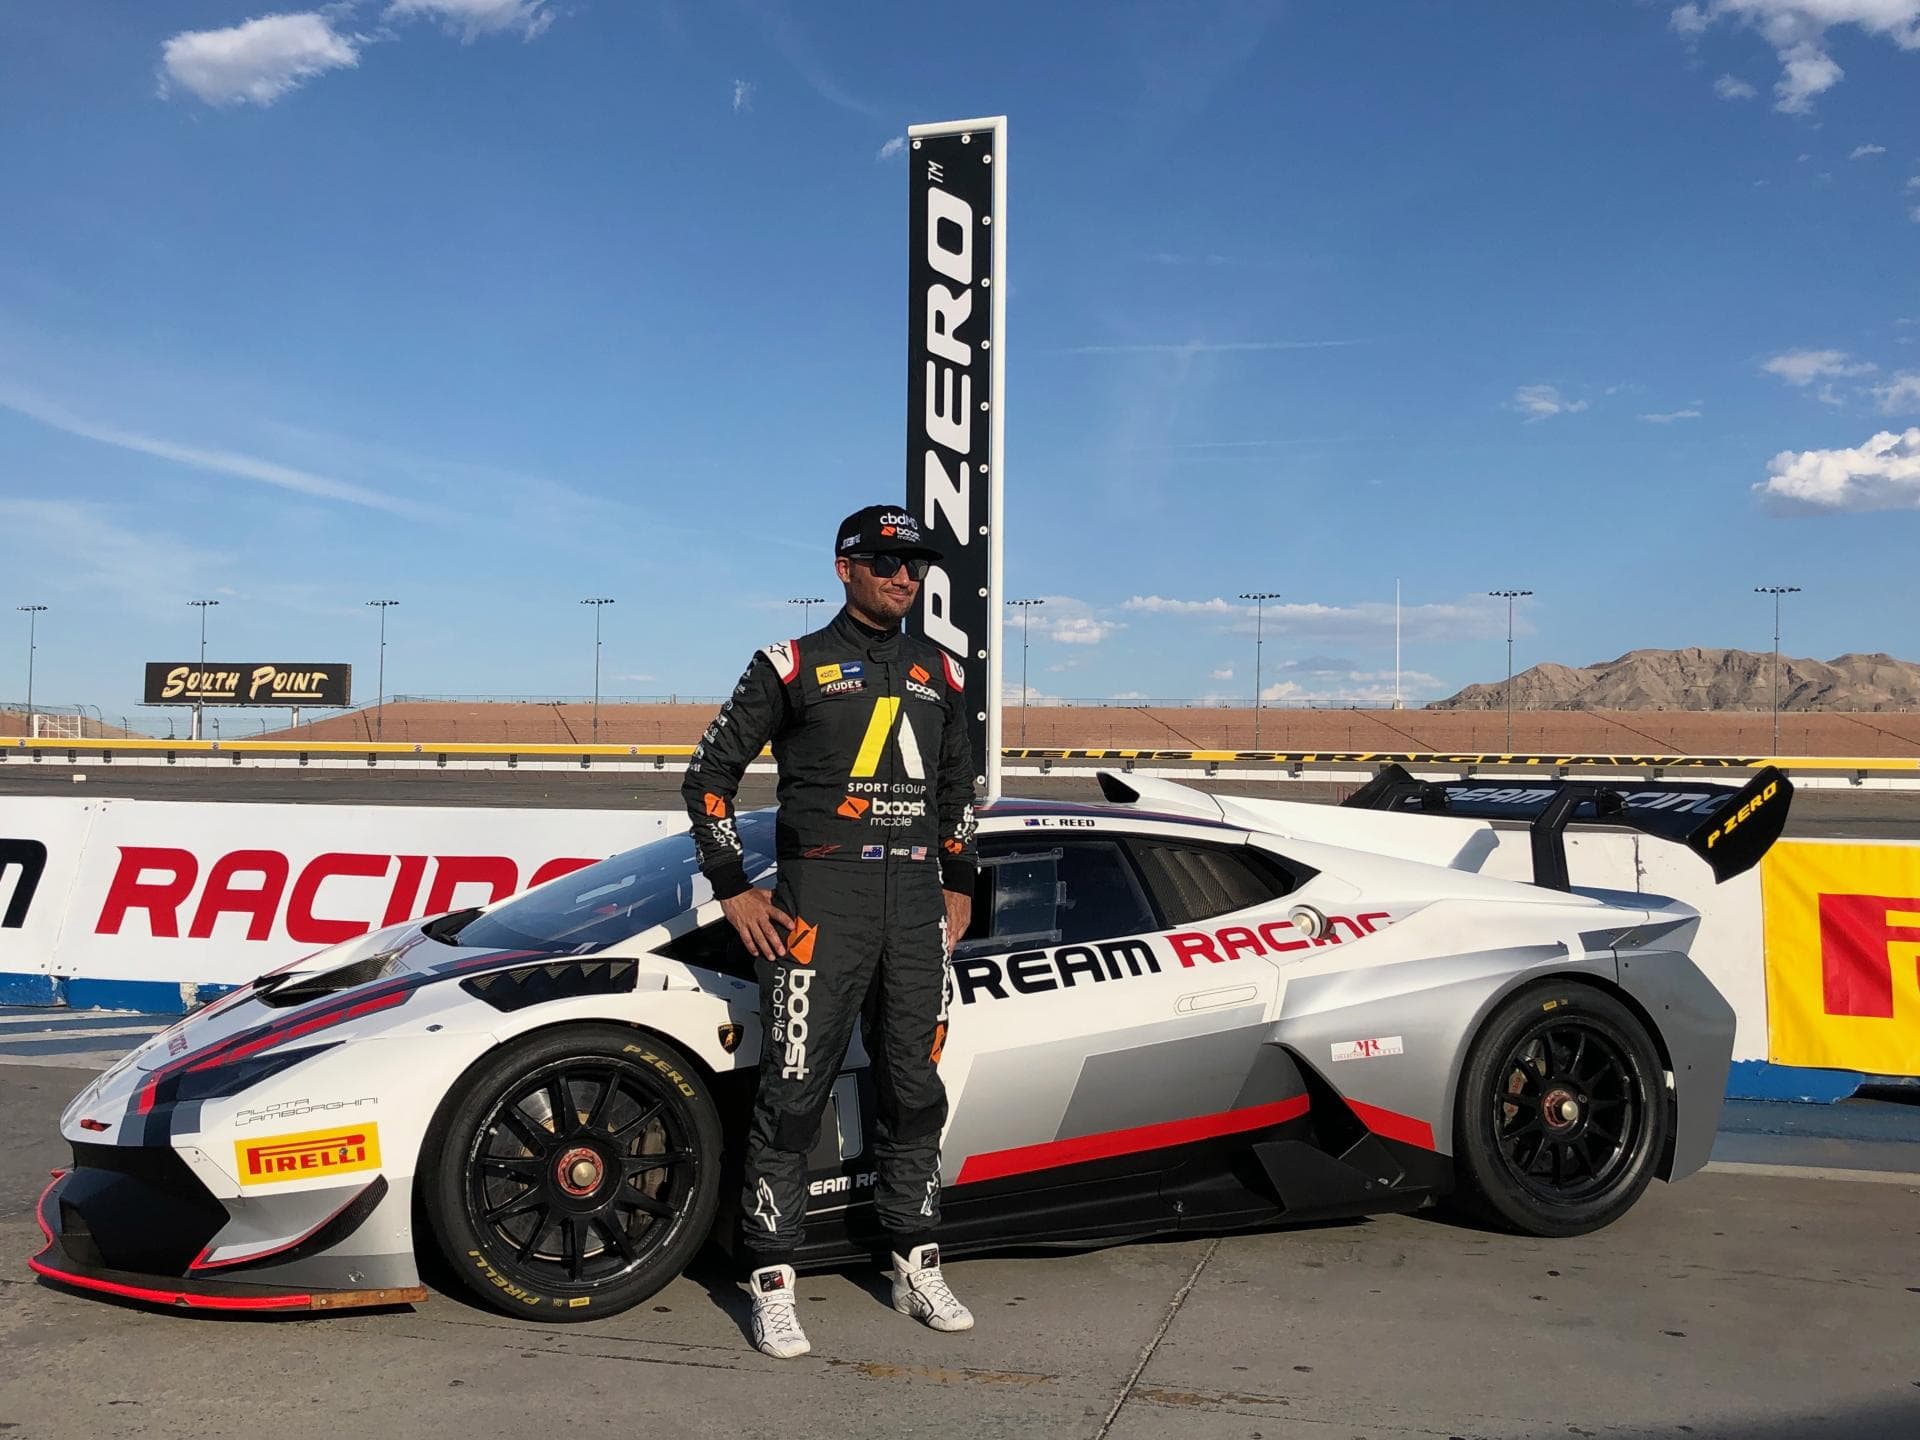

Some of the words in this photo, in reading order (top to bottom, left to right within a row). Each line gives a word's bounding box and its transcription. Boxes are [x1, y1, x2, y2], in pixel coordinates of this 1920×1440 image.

[925, 186, 973, 546] ZERO
[924, 565, 968, 658] P
[1234, 751, 1763, 767] STRAIGHTAWAY
[848, 782, 888, 793] SPORT
[872, 797, 926, 816] boost
[1060, 818, 1095, 827] REED
[1707, 830, 1720, 848] P
[1724, 781, 1778, 834] ZERO
[945, 939, 1162, 1006] REAM
[772, 967, 786, 1042] mobile
[782, 969, 816, 1080] boost
[640, 1052, 695, 1097] ZERO
[235, 1097, 379, 1127] LAMBORGHINI
[236, 1098, 310, 1118] PILOTA
[247, 1134, 366, 1175] PIRELLI
[807, 1176, 852, 1196] EAM
[467, 1250, 541, 1305] PIRELLI
